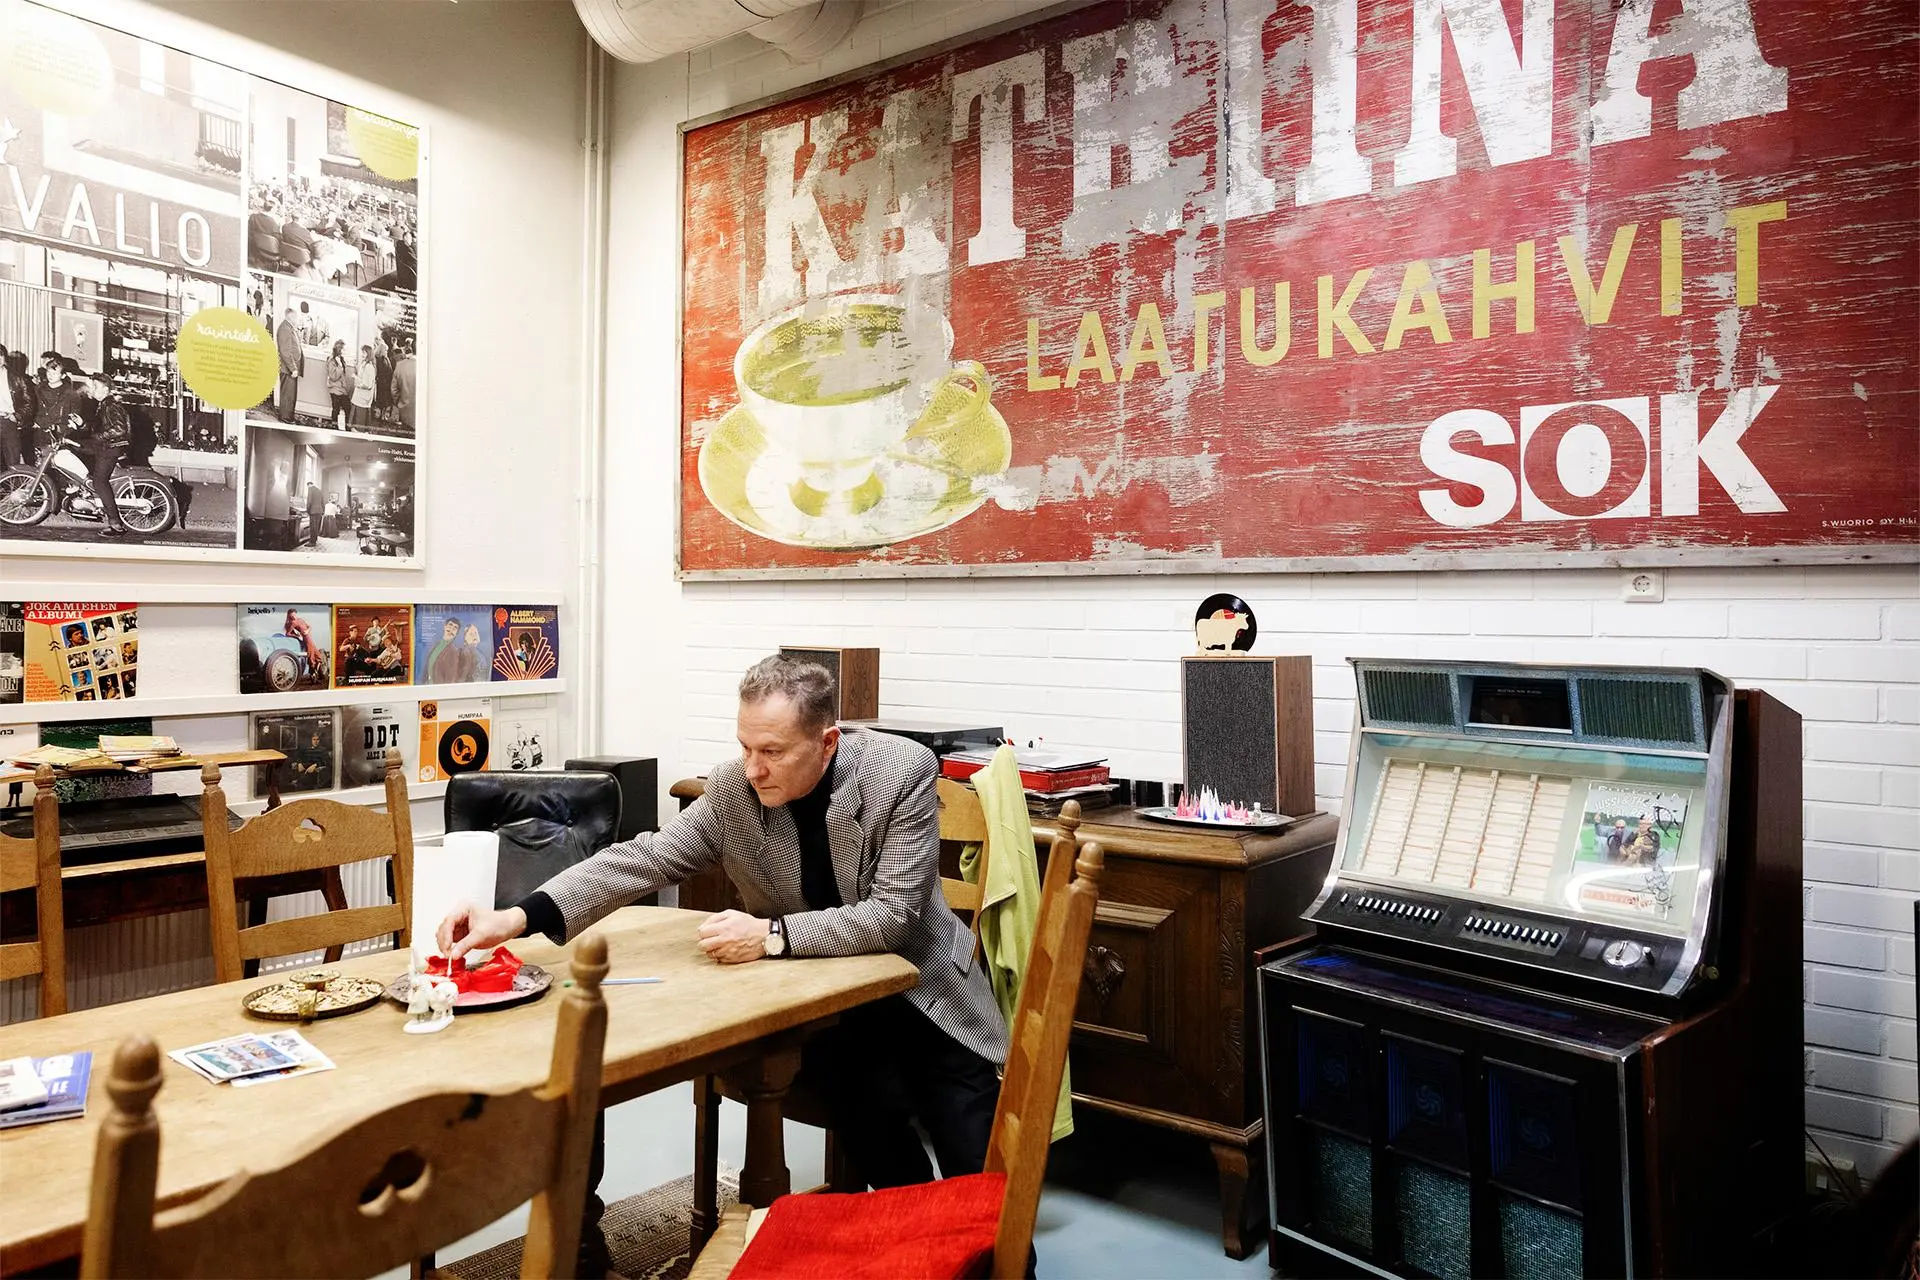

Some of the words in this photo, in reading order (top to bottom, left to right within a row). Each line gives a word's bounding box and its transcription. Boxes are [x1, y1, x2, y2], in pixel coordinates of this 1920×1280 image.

[6, 165, 212, 268] VALIO
[1026, 200, 1788, 392] LAATUKAHVIT
[1418, 384, 1789, 528] SOK
[25, 602, 118, 612] JOKAMIEHEN
[26, 610, 84, 620] ALBUMI
[510, 609, 535, 617] ALBERT
[510, 616, 546, 624] HAMMOND
[457, 712, 484, 720] HUMPPAA
[363, 723, 400, 749] DDT
